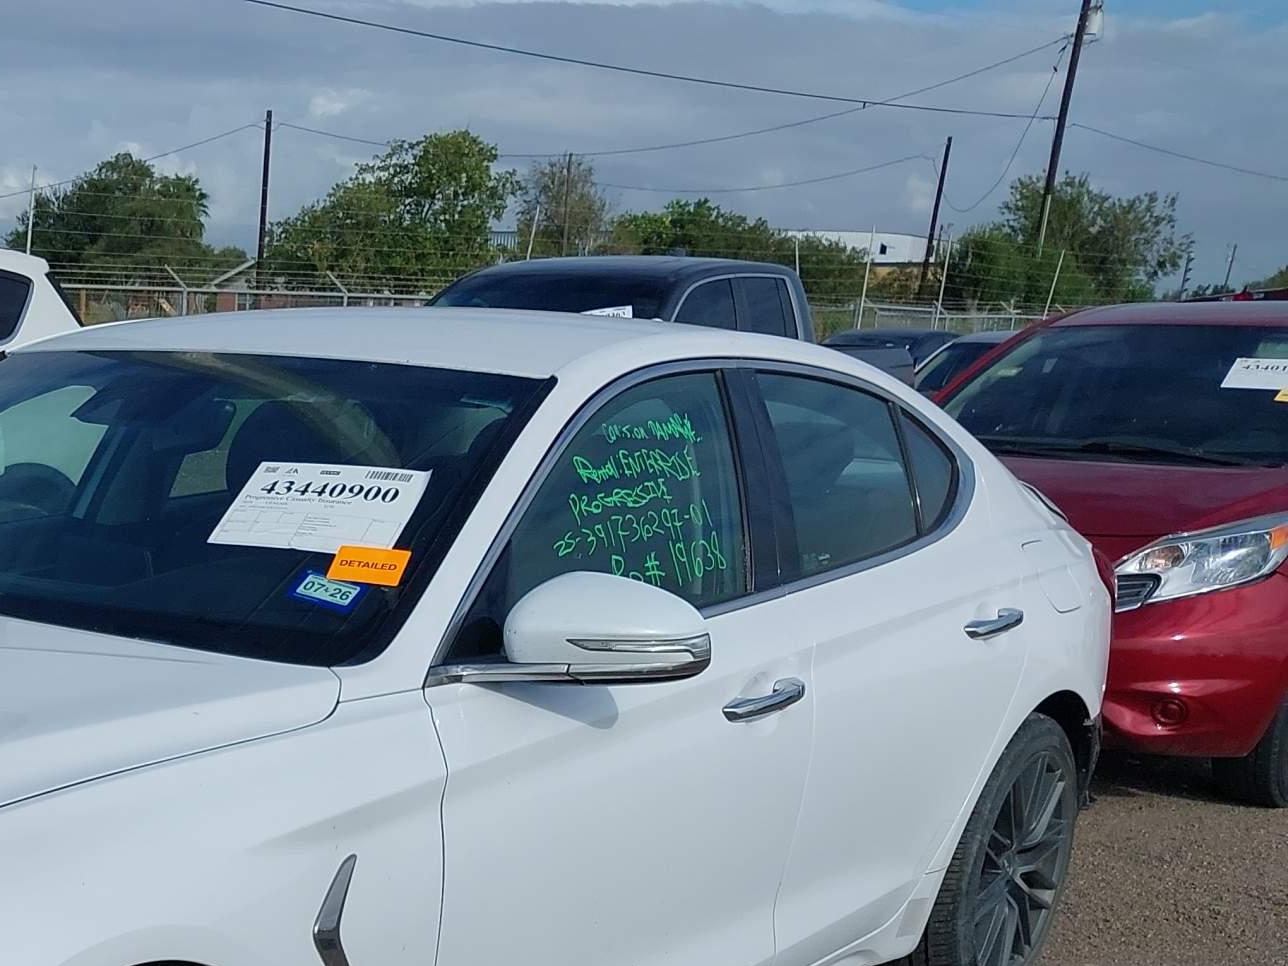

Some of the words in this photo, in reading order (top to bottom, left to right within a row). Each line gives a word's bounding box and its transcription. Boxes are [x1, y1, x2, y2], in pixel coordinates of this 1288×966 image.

[260, 479, 400, 504] 43440900
[339, 560, 398, 571] DETAILED
[669, 530, 727, 586] 19638
[303, 580, 327, 594] 07
[327, 587, 353, 602] 26
